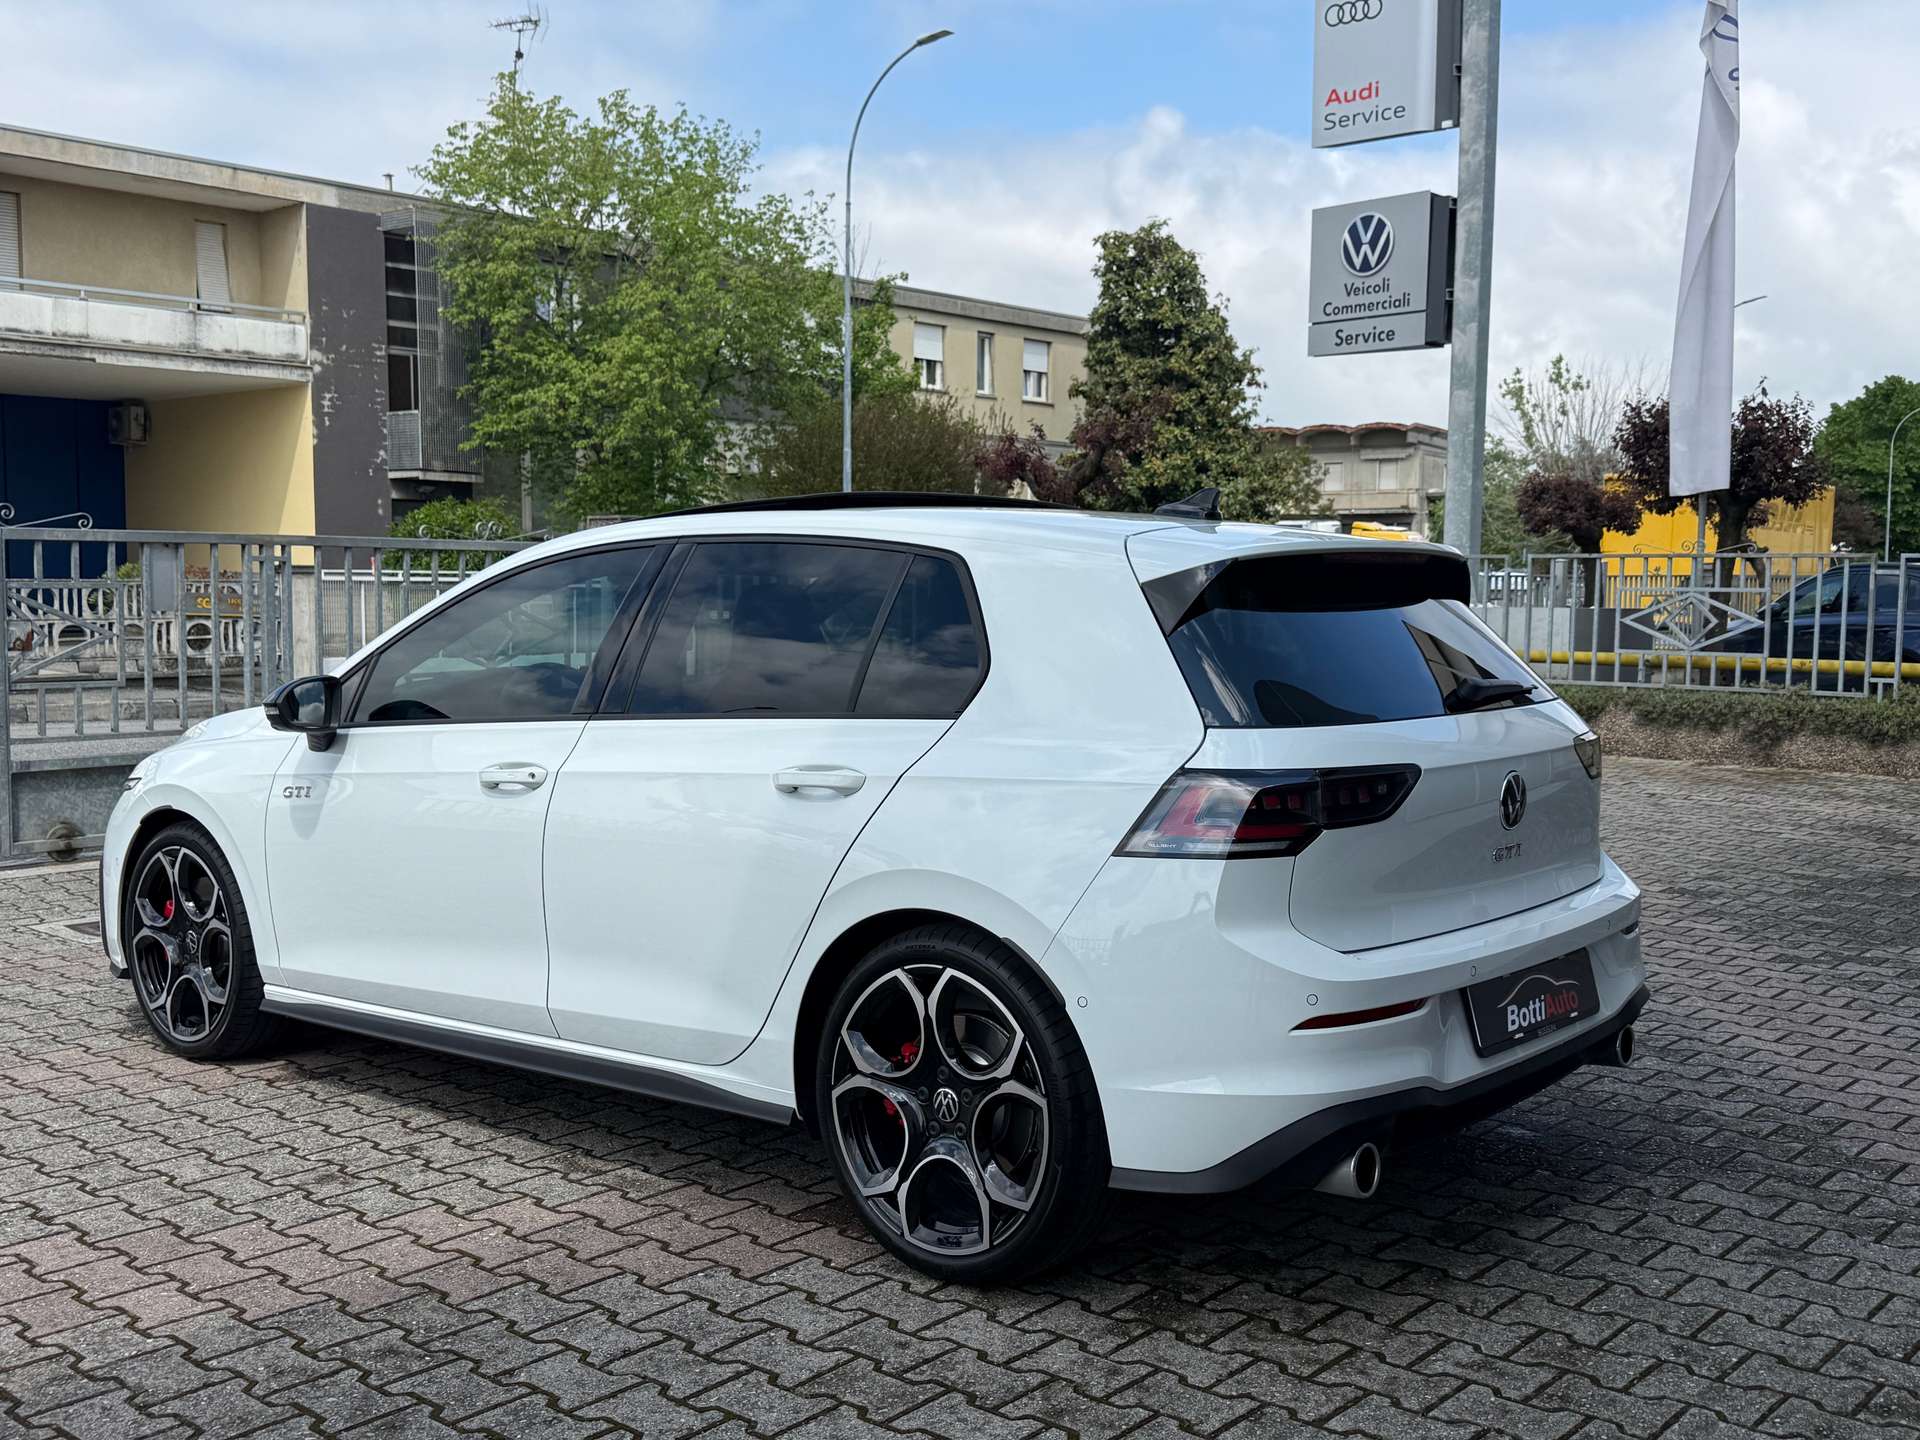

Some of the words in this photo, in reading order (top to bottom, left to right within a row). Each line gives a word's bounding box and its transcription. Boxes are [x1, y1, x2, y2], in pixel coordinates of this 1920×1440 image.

[1325, 80, 1380, 107] Audi
[1323, 104, 1406, 131] Service
[1344, 277, 1391, 297] Veicoli
[1323, 291, 1411, 317] Commerciali
[1334, 326, 1396, 347] Service
[283, 785, 312, 799] GTI
[1507, 990, 1579, 1033] BottiAuto
